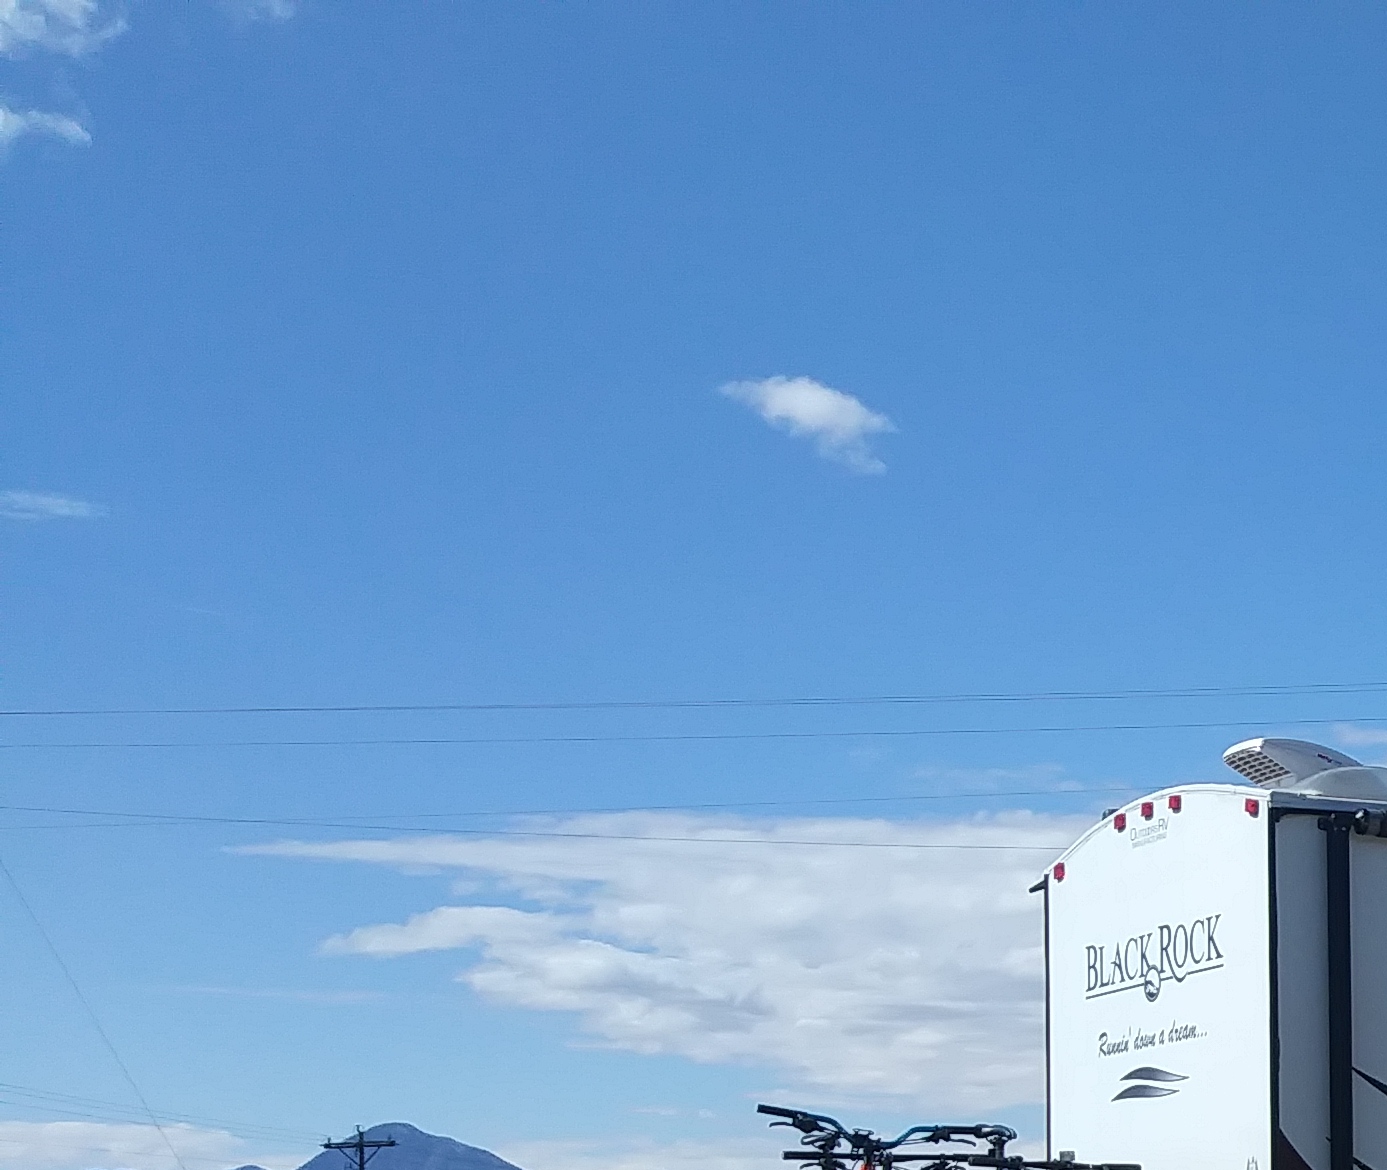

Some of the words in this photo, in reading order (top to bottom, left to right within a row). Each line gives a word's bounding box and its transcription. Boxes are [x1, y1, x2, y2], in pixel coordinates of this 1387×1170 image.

[1085, 932, 1153, 992] BLACK
[1158, 914, 1224, 983] ROCK
[1134, 1028, 1156, 1050] down
[1159, 1030, 1165, 1046] a
